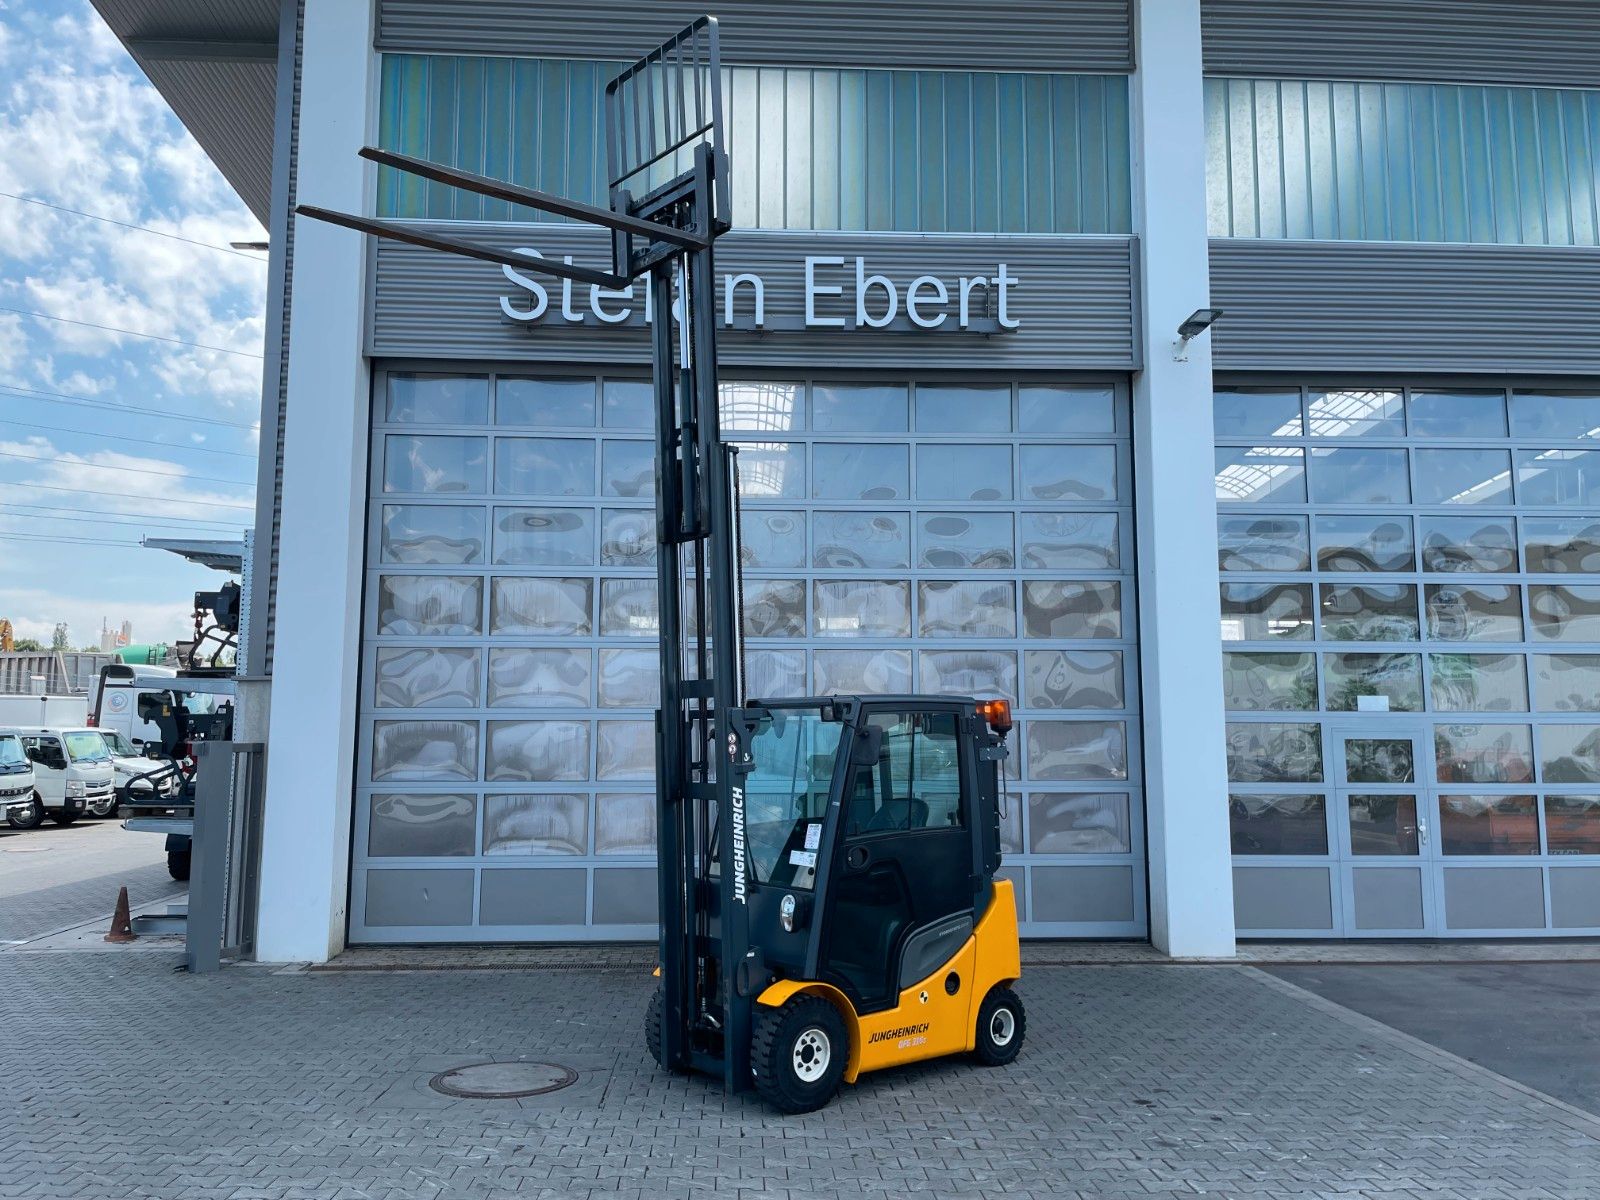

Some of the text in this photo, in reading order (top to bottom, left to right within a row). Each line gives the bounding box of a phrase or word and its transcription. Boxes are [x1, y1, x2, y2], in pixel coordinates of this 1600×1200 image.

[804, 255, 1020, 329] Ebert
[732, 786, 746, 905] JUNGHEINRICH
[868, 1022, 929, 1044] JUNGHEINRICH
